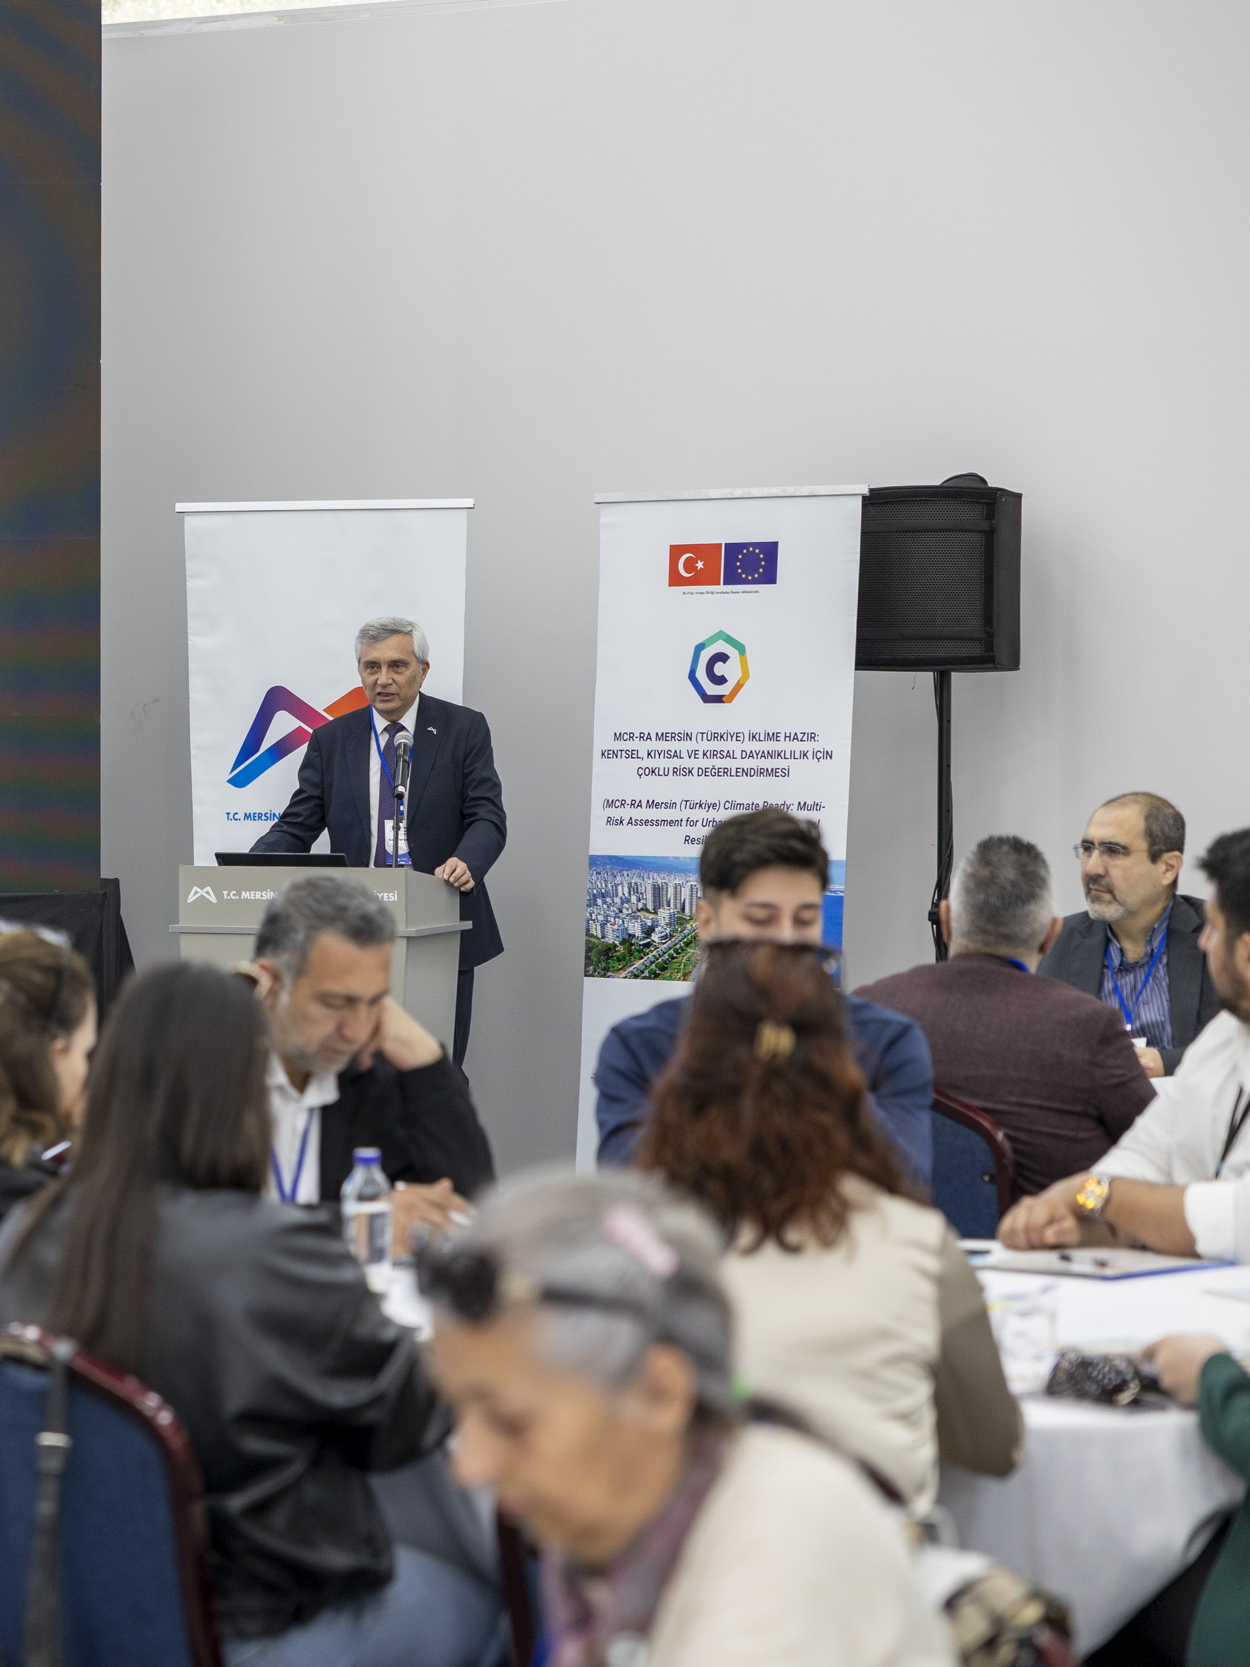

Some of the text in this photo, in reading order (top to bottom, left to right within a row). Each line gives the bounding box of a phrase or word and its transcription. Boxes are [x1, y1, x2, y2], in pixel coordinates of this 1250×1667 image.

[613, 729, 820, 744] MCR-RA MERSİN (TÜRKİYE) İKLİME HAZIR:
[600, 747, 833, 763] KENTSEL, KIYISAL VE KIRSAL DAYANIKLILIK İÇİN
[636, 764, 790, 779] ÇOKLU RİSK DEĞERLENDİRMESİ
[602, 798, 643, 811] (MCR-RA
[645, 799, 678, 810] Mersin
[679, 799, 721, 812] (Türkiye)
[723, 800, 760, 811] Climate
[796, 801, 826, 812] Multi-
[225, 809, 281, 821] T.C. MERSİN
[605, 816, 726, 828] Risk Assessment for Urba
[222, 890, 239, 899] T.C.
[240, 888, 278, 900] MERSİN
